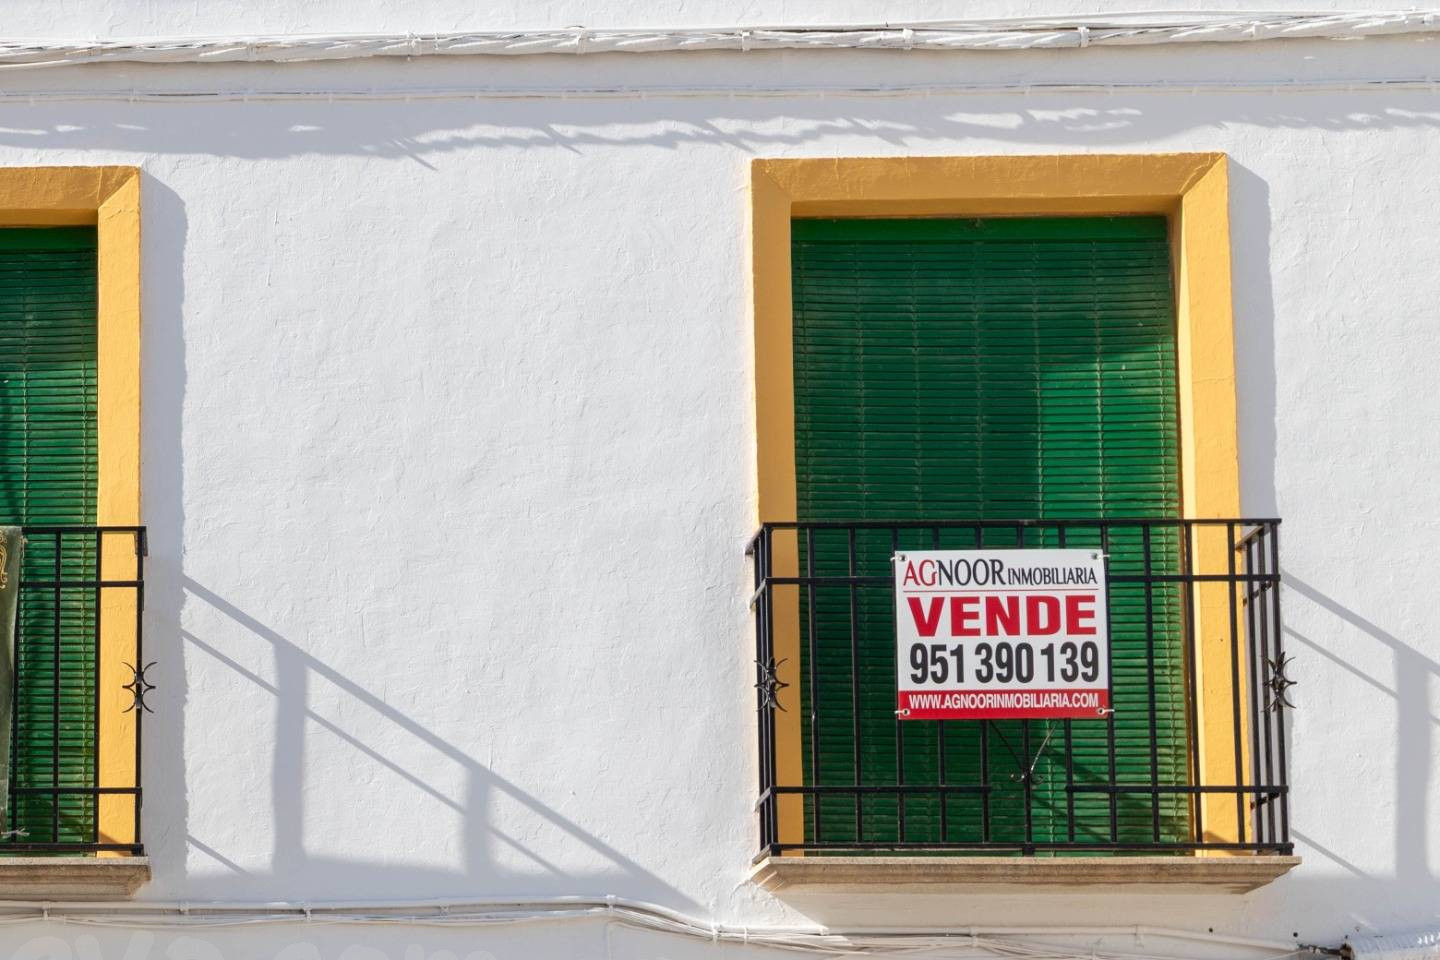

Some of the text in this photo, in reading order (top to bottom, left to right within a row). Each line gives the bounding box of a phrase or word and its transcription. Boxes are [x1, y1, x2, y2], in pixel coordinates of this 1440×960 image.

[903, 558, 1098, 586] AGNOOR INMOBILIARIA
[907, 595, 1097, 637] VENDE
[910, 641, 1099, 684] 951 390 139
[908, 692, 1099, 709] WWW.AGNOORINMOBILIARIA.COM
